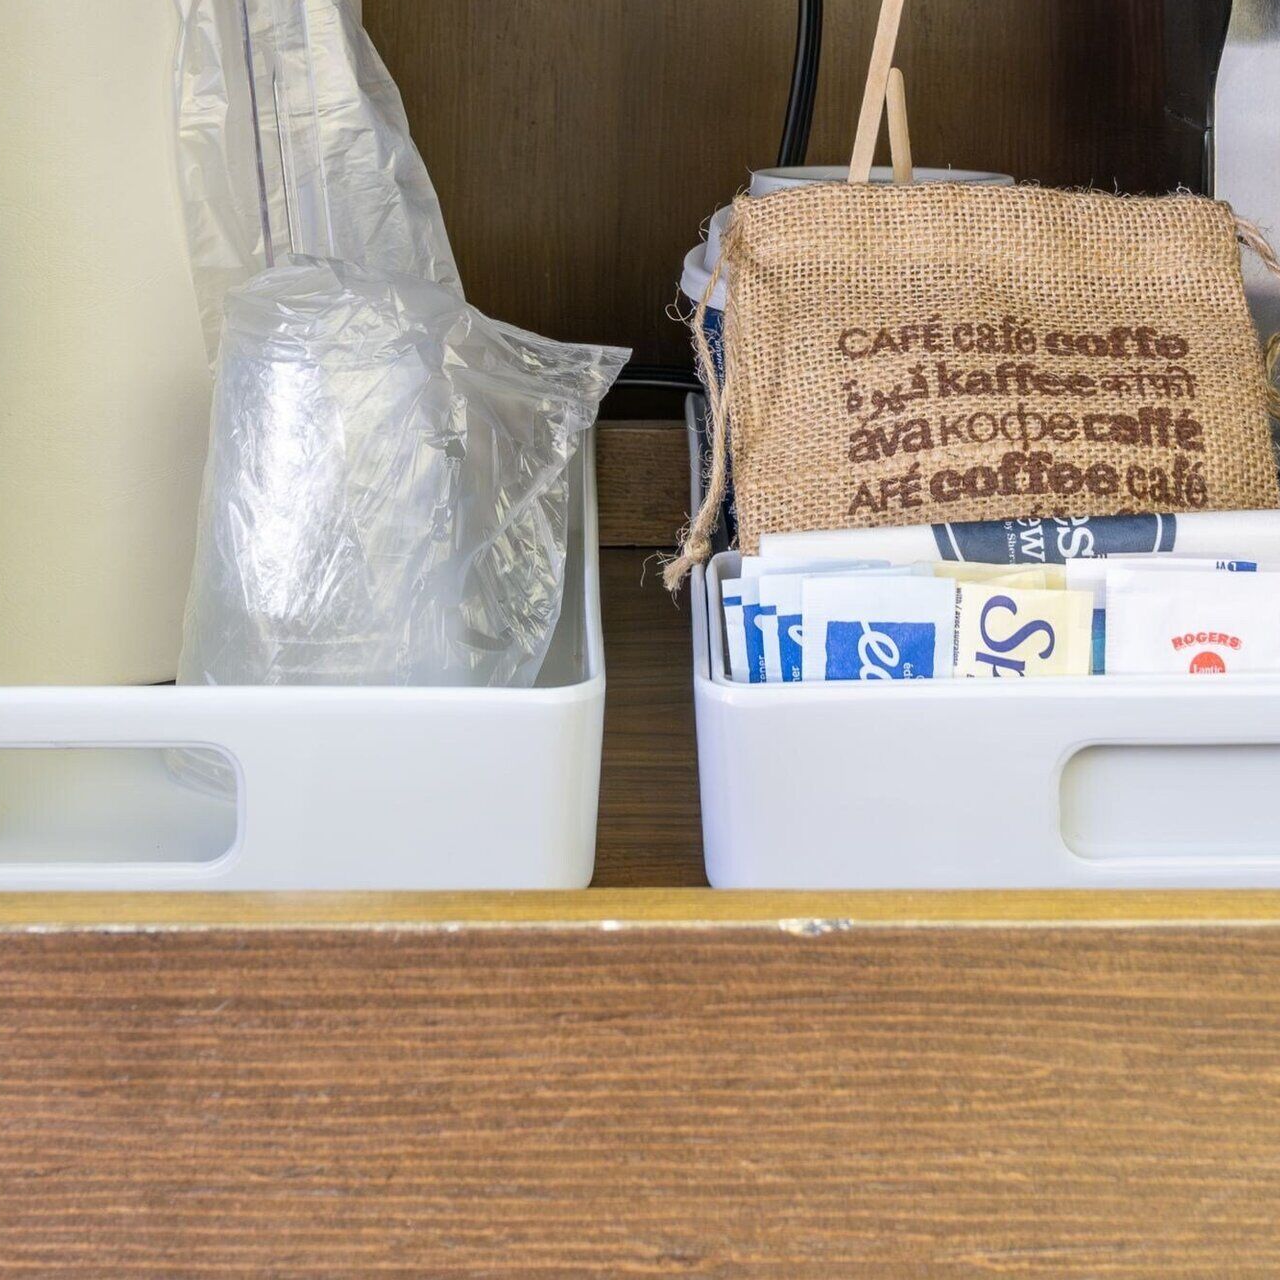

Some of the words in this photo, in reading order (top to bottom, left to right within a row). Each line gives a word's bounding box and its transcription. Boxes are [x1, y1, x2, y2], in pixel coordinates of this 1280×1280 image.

[838, 313, 946, 360] CAFÉ
[929, 451, 1119, 503] coffee
[1171, 632, 1242, 651] ROGERS
